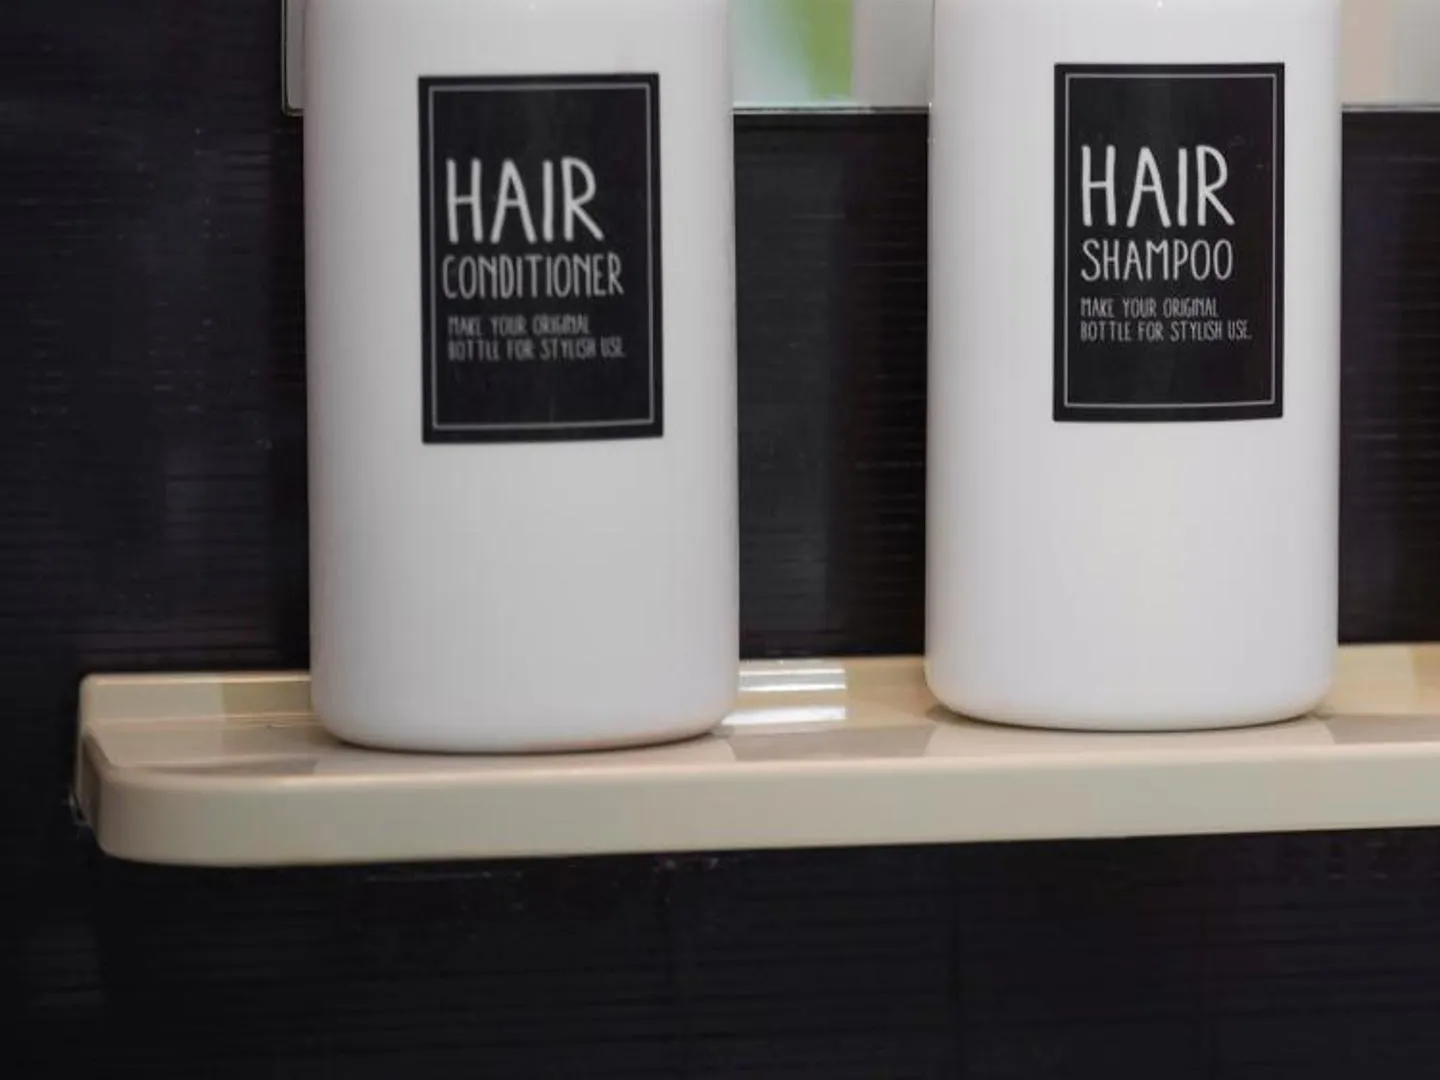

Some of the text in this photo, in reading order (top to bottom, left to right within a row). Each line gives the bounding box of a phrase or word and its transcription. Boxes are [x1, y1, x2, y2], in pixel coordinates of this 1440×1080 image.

[446, 157, 604, 244] HAIR
[1082, 145, 1235, 227] HAIR
[442, 252, 624, 299] CONDITIONER
[1080, 239, 1233, 282] SHAMPOO
[1080, 297, 1218, 318] MAKE YOUR ORIGINAL
[448, 315, 482, 336] MAKE
[491, 314, 527, 336] YOUR
[1080, 321, 1131, 342] BOTTLE
[1138, 320, 1164, 342] FOR
[1170, 320, 1222, 342] STYLISH
[448, 340, 499, 361] BOTTLE
[507, 338, 534, 361] FOR
